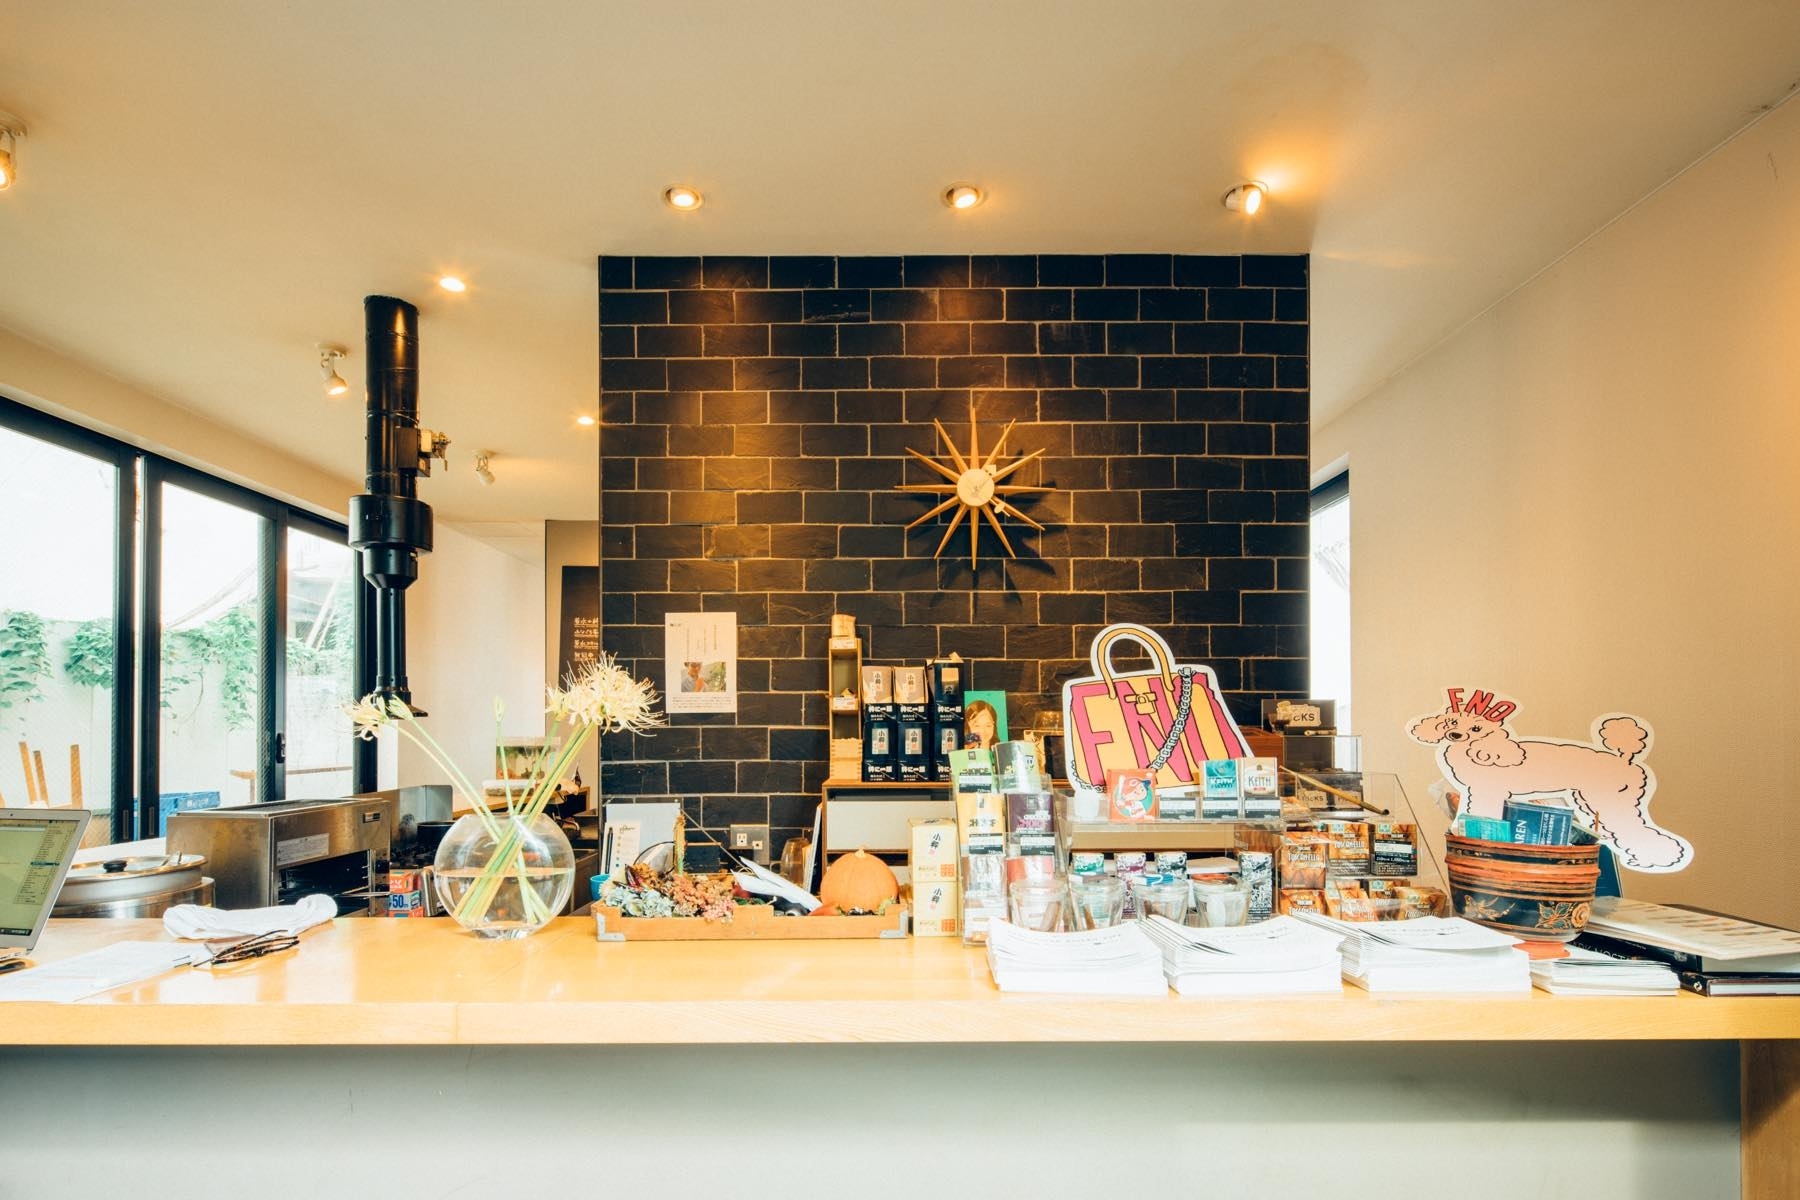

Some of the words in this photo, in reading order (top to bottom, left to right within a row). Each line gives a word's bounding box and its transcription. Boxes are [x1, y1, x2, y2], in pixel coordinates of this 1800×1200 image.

[1447, 687, 1517, 722] FNO
[1070, 673, 1244, 787] FNO
[1248, 776, 1272, 787] KEITH
[1514, 819, 1527, 844] AREN
